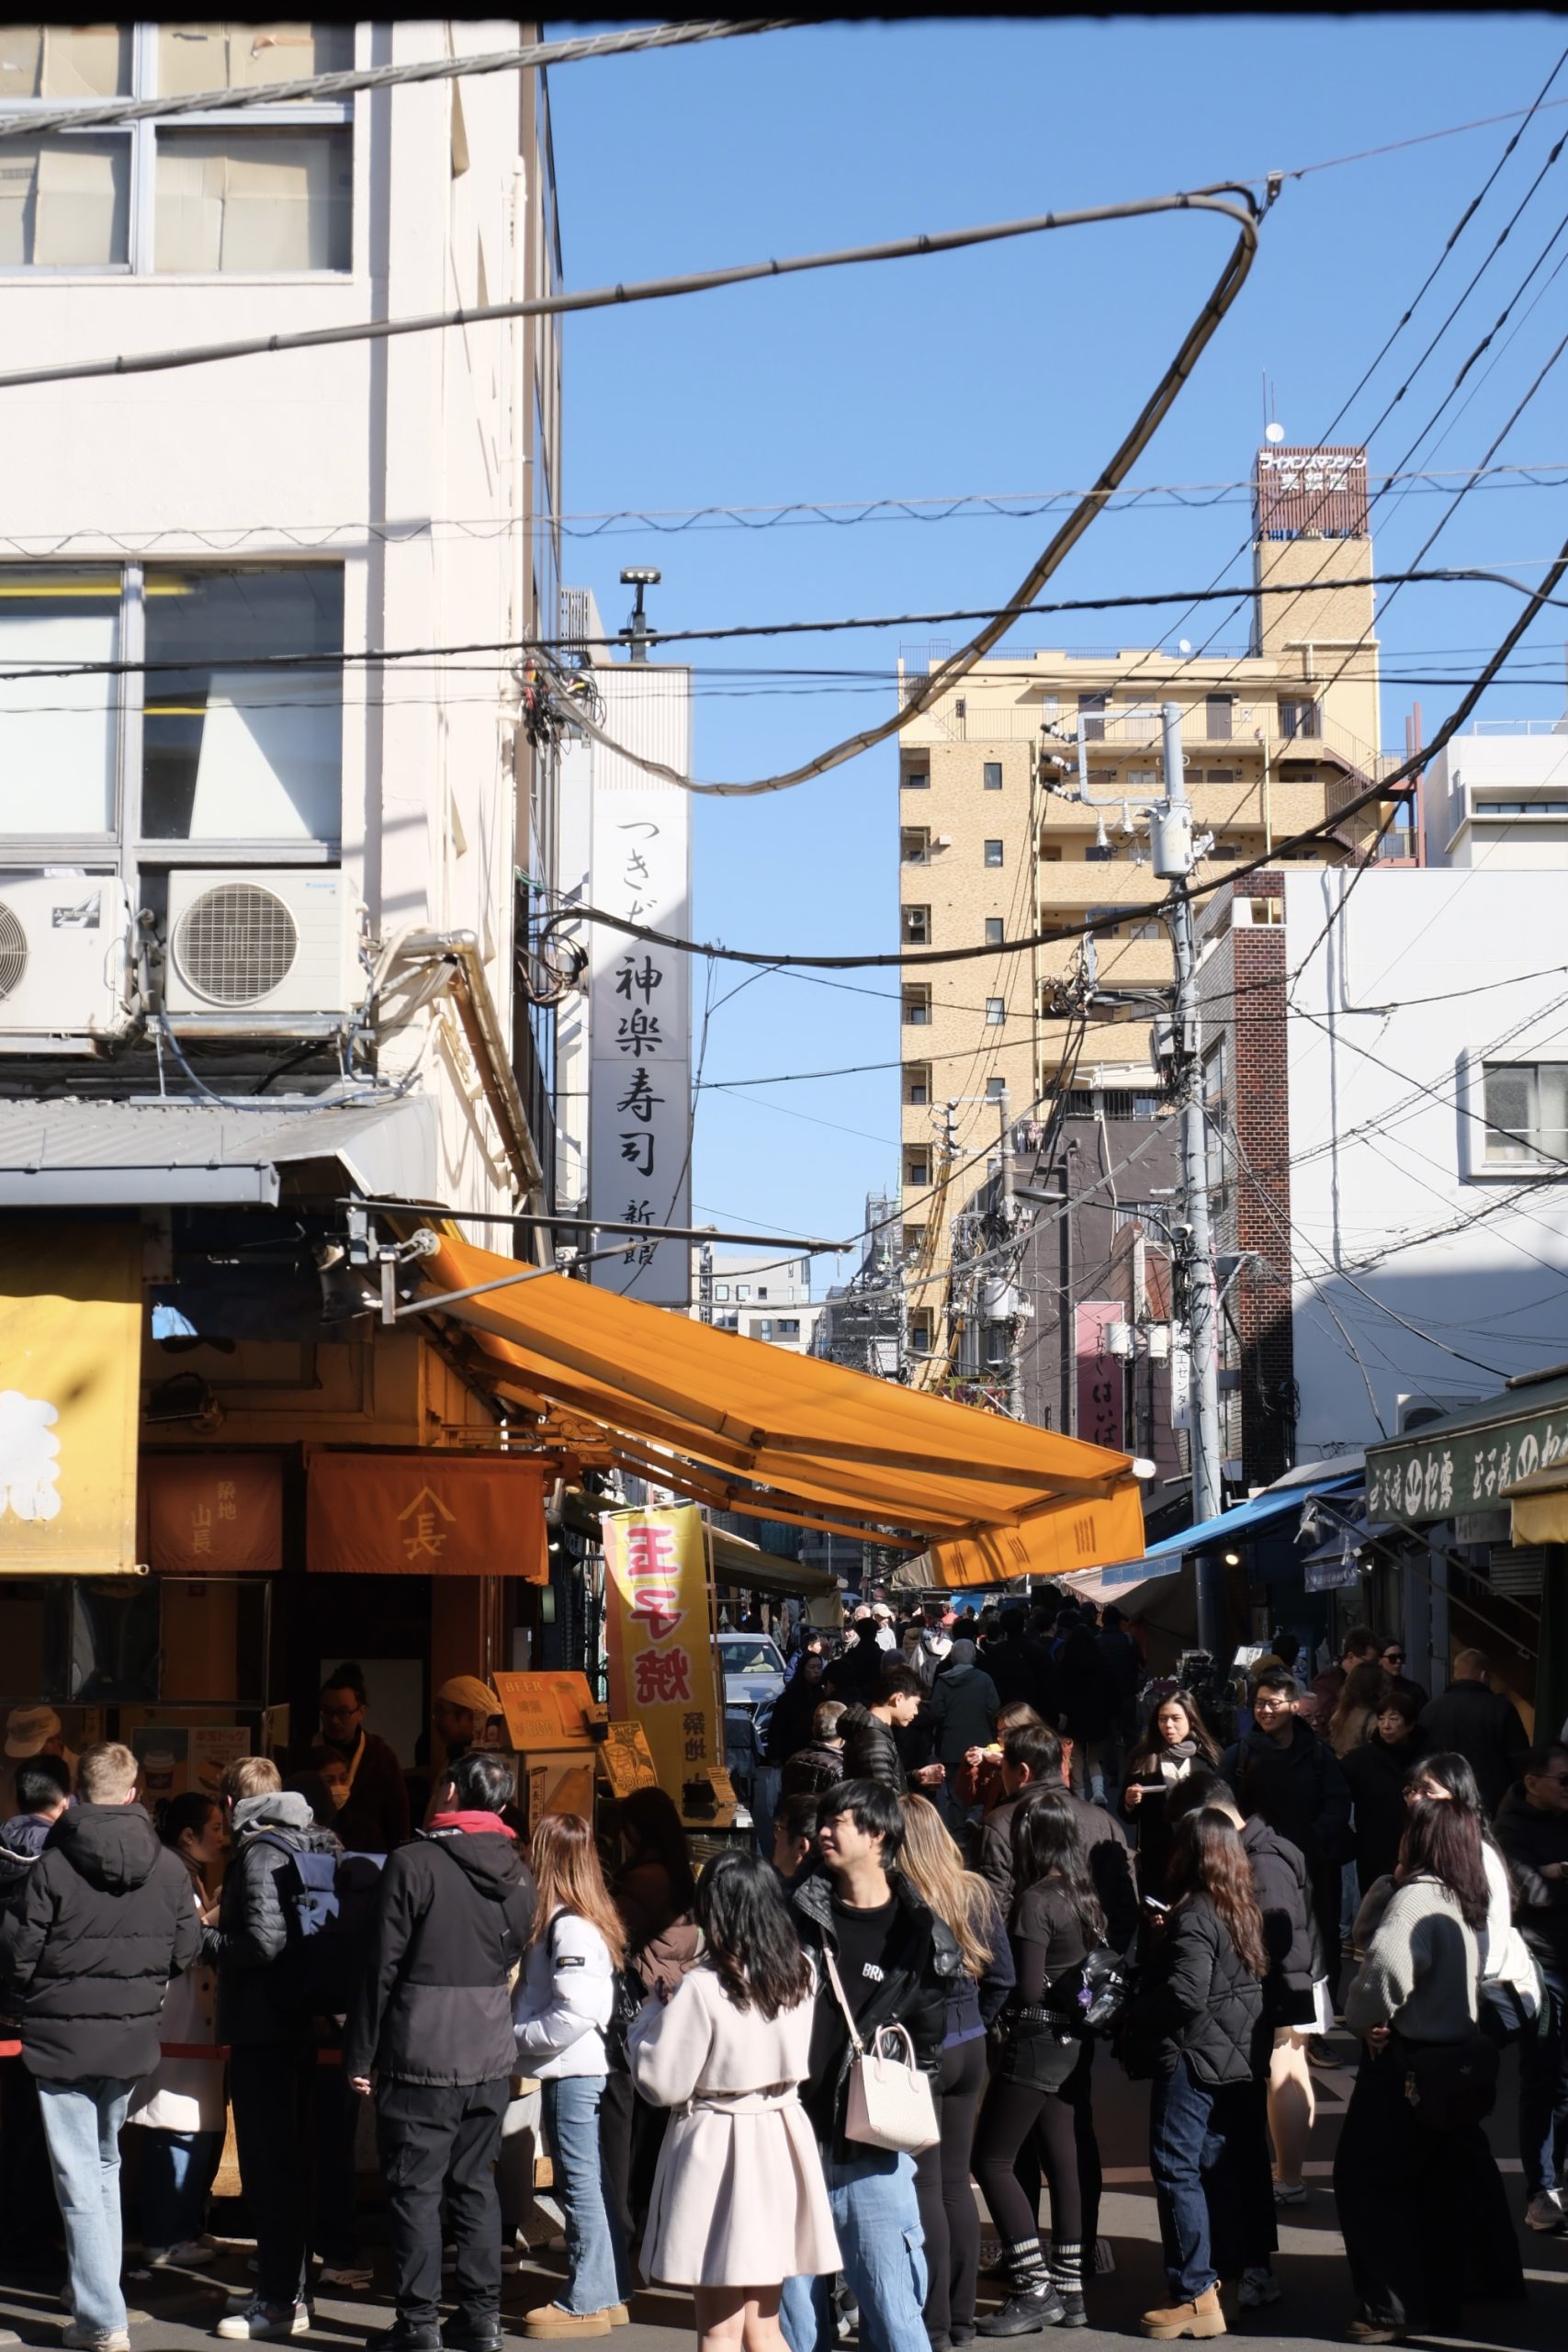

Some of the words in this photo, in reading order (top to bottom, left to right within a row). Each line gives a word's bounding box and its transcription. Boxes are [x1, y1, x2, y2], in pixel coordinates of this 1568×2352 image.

[1259, 452, 1367, 470] ライオンズマンション
[1280, 471, 1348, 492] 東銀座
[615, 955, 665, 1178] 神楽寿司
[191, 1503, 212, 1555] 山長
[505, 1681, 544, 1692] BEER
